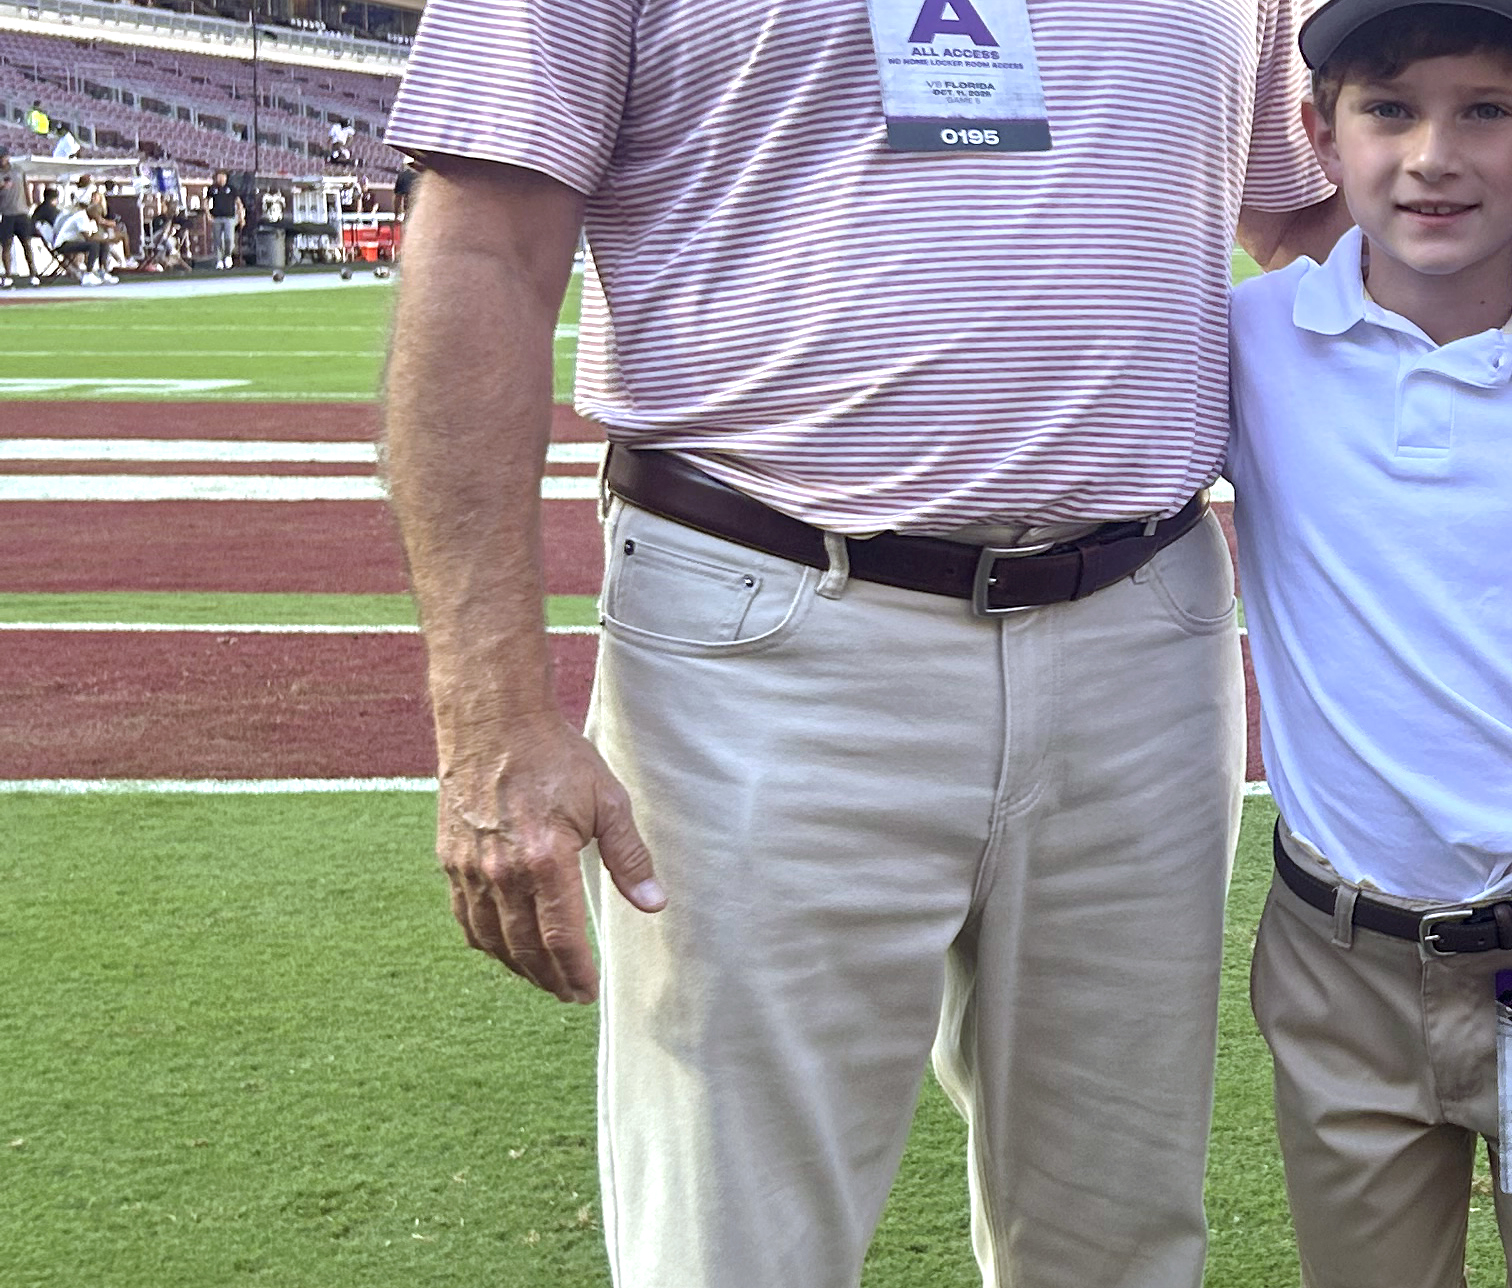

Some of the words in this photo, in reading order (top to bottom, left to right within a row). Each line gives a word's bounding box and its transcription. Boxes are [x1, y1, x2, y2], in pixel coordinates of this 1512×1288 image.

[911, 47, 939, 57] ALL
[943, 48, 1000, 60] ACCESS
[930, 59, 963, 67] LOCKER
[992, 62, 1024, 70] ACCESS
[944, 81, 996, 90] FLORIDA
[941, 128, 1000, 145] 0195
